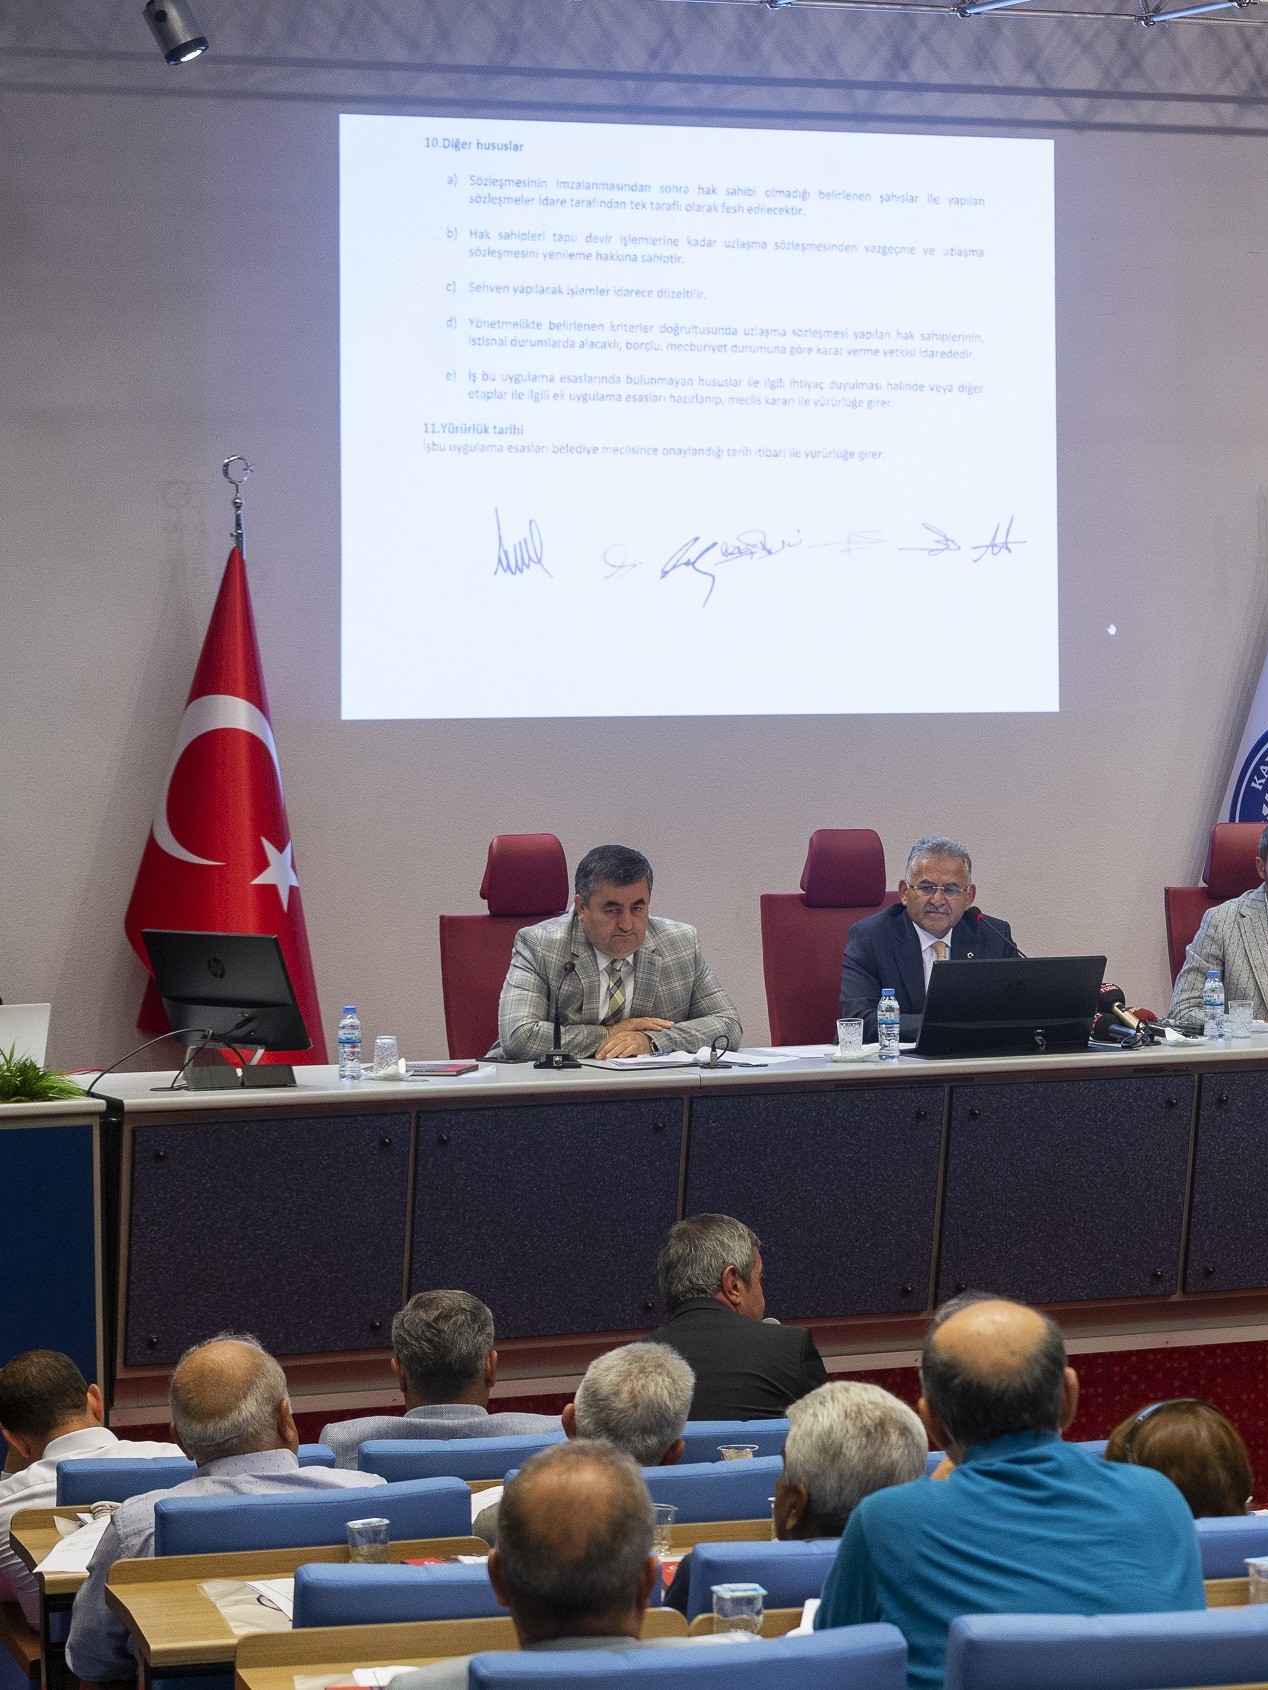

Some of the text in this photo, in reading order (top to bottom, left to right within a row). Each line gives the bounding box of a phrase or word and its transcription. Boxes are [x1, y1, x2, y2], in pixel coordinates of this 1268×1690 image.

[475, 138, 524, 152] hususlar
[447, 173, 985, 208] a) Sözleşmesinin imzalanmasından sonra hak sahibi olmadığı belirlenen şahıslar ile yapılan
[469, 192, 536, 207] sözleşmeler
[569, 197, 627, 209] tarafından
[629, 199, 649, 211] tek
[649, 200, 683, 212] taraflı
[684, 201, 720, 213] olarak
[720, 202, 746, 214] fesh
[446, 227, 984, 258] b) Hak sahipleri tapu devir işlemlerine kadar uzlaşma sözleşmesinden vazgeçme ve uzlaşma
[468, 246, 684, 265] sözleşmesini yenileme hakkına sahiptir.
[445, 281, 456, 294] c)
[469, 281, 511, 294] Sehven
[512, 284, 564, 296] yapılacak
[567, 285, 611, 298] işlemler
[613, 286, 653, 298] idarece
[446, 316, 457, 330] d)
[468, 317, 543, 331] Yönetmelikte
[548, 320, 605, 332] belirlenen
[609, 321, 654, 334] kriterler
[659, 323, 738, 337] doğrultusunda
[744, 326, 787, 338] uzlaşma
[792, 327, 848, 340] sözleşmesi
[853, 329, 891, 341] yapılan
[896, 330, 915, 341] hak
[509, 336, 576, 349] durumlarda
[666, 341, 728, 354] mecburiyet
[730, 343, 787, 354] durumuna
[789, 345, 814, 356] göre
[815, 345, 844, 356] karar
[846, 348, 880, 357] verme
[883, 347, 916, 358] yetkisi
[445, 370, 457, 382] e)
[481, 370, 496, 382] bu
[501, 371, 555, 385] uygulama
[559, 373, 622, 385] esaslarında
[625, 374, 694, 388] bulunmayan
[698, 376, 743, 388] hususlar
[747, 377, 760, 388] ile
[764, 378, 785, 391] ilgili
[790, 378, 825, 392] ihtiyaç
[829, 379, 882, 392] duyulması
[887, 381, 925, 392] halinde
[929, 384, 953, 394] veya
[958, 383, 983, 395] diğer
[467, 388, 508, 401] etaplar
[511, 389, 525, 400] ile
[528, 389, 550, 404] ilgili
[552, 390, 565, 401] ek
[569, 391, 623, 404] uygulama
[624, 392, 666, 403] esasları
[728, 395, 762, 405] meclis
[798, 396, 811, 406] ile
[813, 396, 864, 410] yürürlüğe
[867, 399, 893, 410] girer.
[492, 423, 524, 436] tarihi
[448, 442, 504, 455] uygulama
[506, 443, 548, 454] esasları
[552, 443, 599, 456] belediye
[602, 445, 659, 456] meclisince
[662, 446, 724, 459] onaylandığı
[727, 447, 752, 457] tarih
[789, 448, 801, 458] ile
[804, 449, 855, 461] yürürlüğe
[858, 451, 884, 461] girer.
